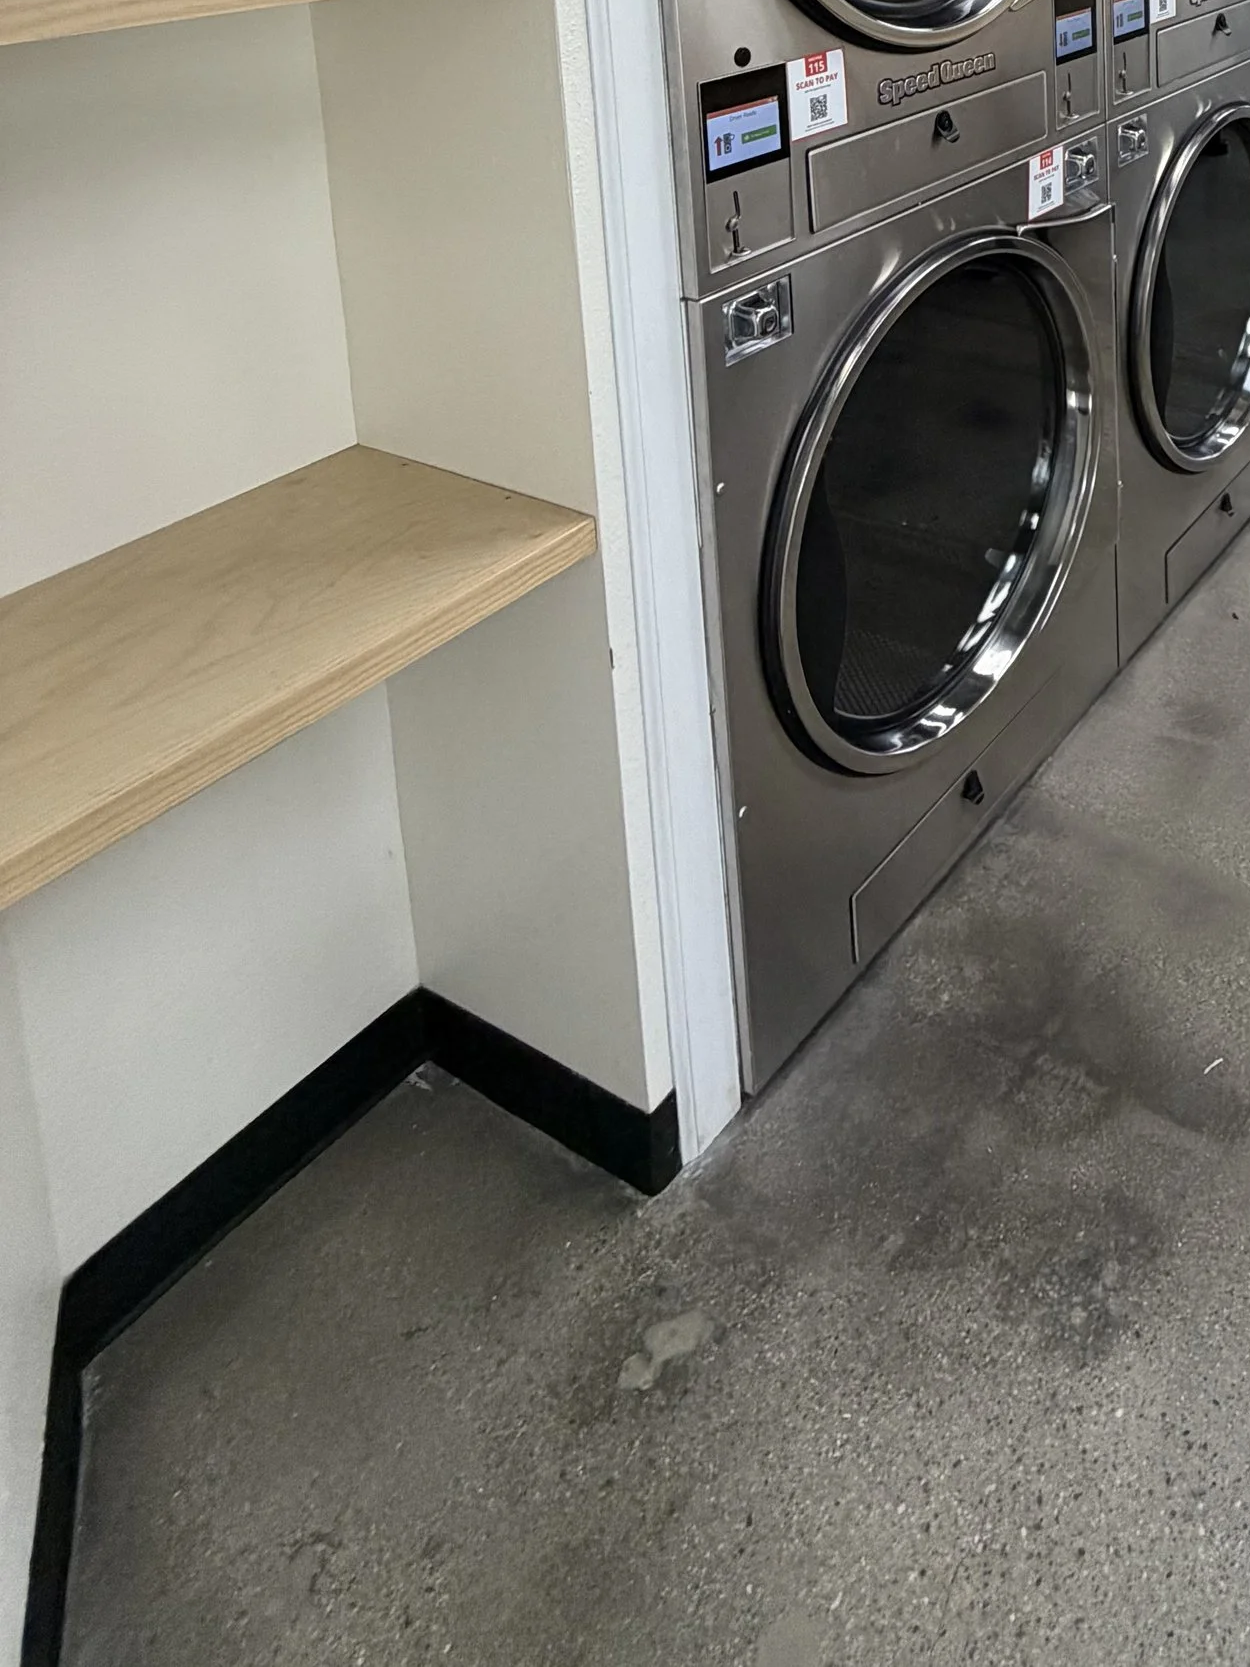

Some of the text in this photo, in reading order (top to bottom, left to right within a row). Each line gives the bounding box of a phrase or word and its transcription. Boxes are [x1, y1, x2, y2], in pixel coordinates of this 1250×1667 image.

[808, 60, 825, 74] 115
[795, 79, 814, 91] SCAN
[816, 76, 825, 85] TO
[825, 72, 838, 83] PAY
[878, 52, 996, 106] Speed Queen
